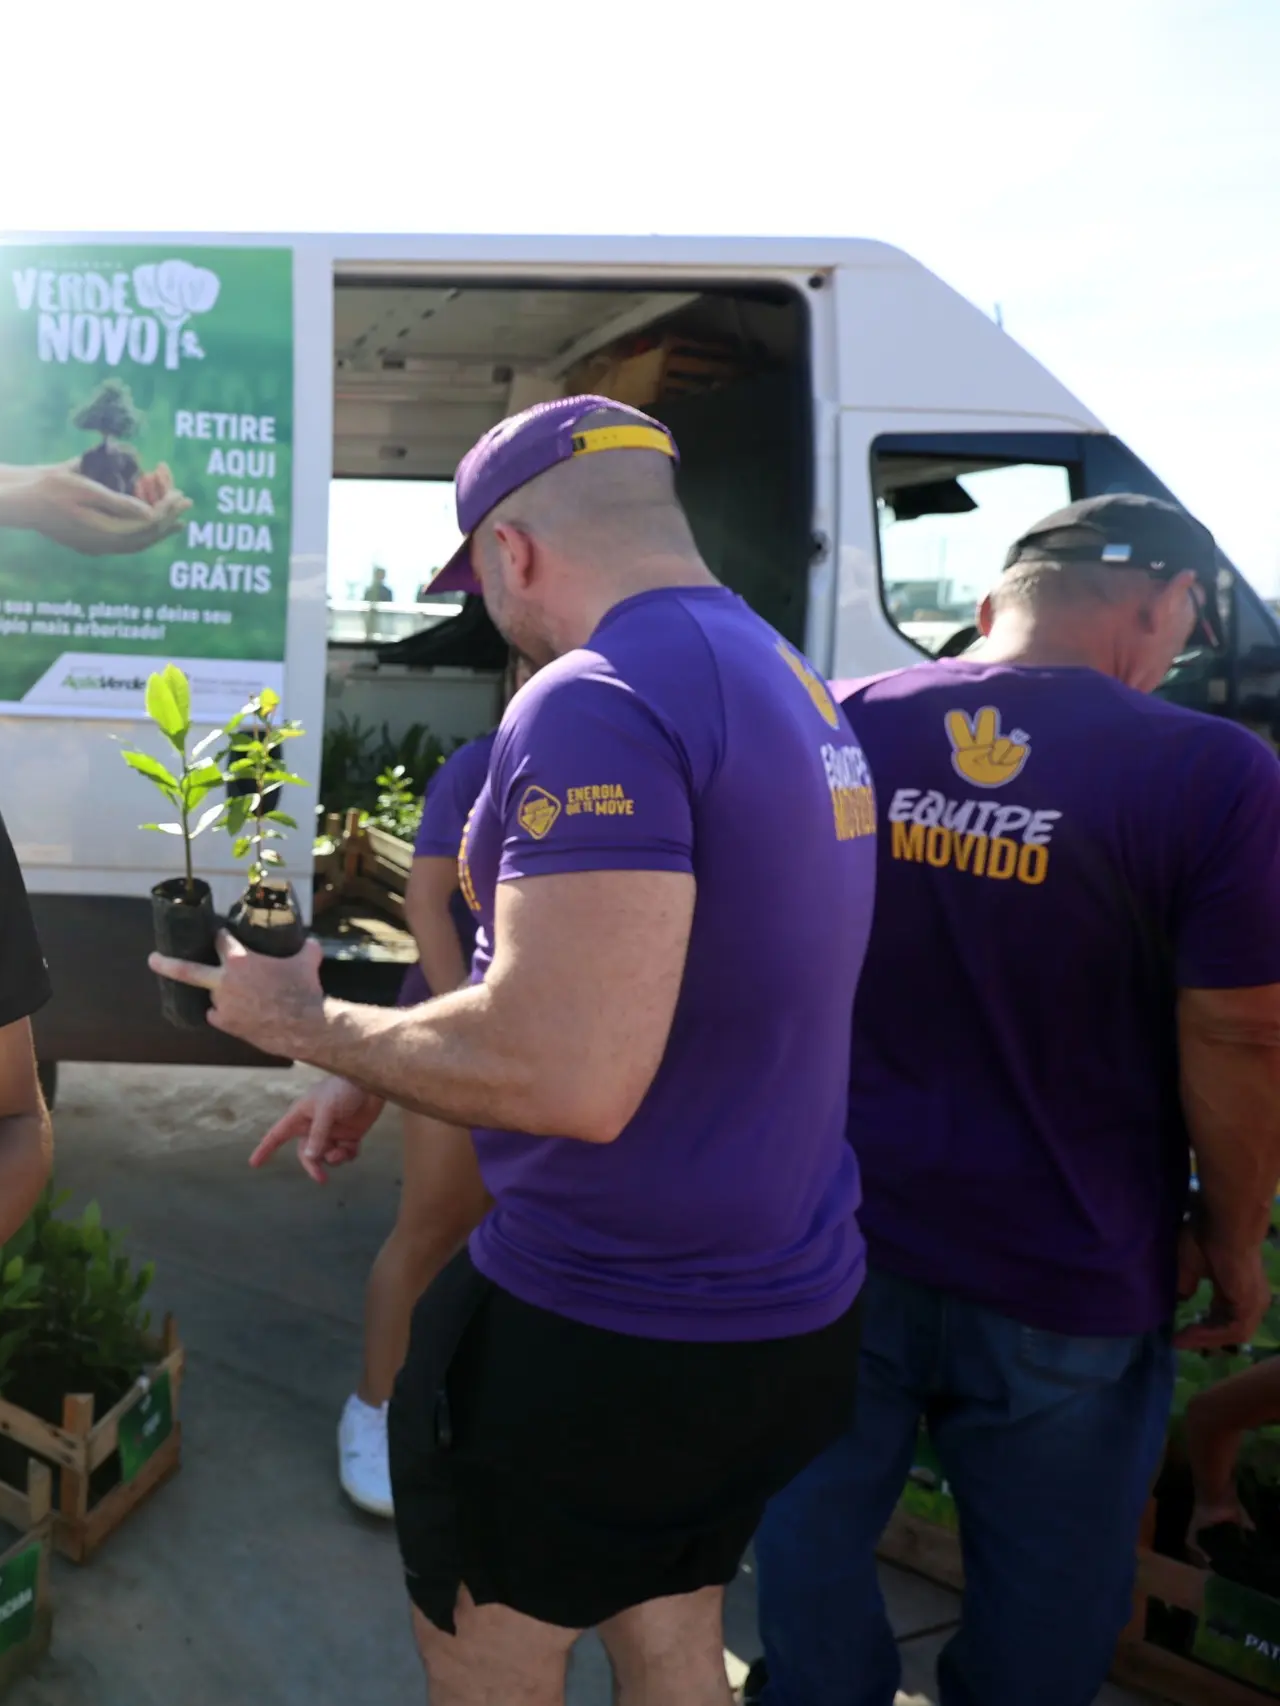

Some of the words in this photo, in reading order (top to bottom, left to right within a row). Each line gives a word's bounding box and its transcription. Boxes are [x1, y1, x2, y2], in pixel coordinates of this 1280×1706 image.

[12, 267, 133, 314] VERDE
[37, 313, 159, 366] NOVO
[175, 410, 276, 443] RETIRE
[207, 447, 276, 479] AQUI
[217, 485, 275, 516] SUA
[188, 520, 273, 554] MUDA
[169, 555, 272, 594] GRÁTIS
[4, 600, 33, 614] sua
[88, 602, 140, 620] plante
[143, 606, 154, 621] e
[156, 604, 200, 623] deixe
[202, 609, 232, 624] seu
[31, 618, 70, 636] mais
[73, 619, 166, 640] arborizado!
[566, 784, 624, 803] ENERGIA
[595, 799, 635, 816] MOVE
[888, 788, 1063, 845] EQUIPE
[890, 820, 1049, 885] MOVIDO
